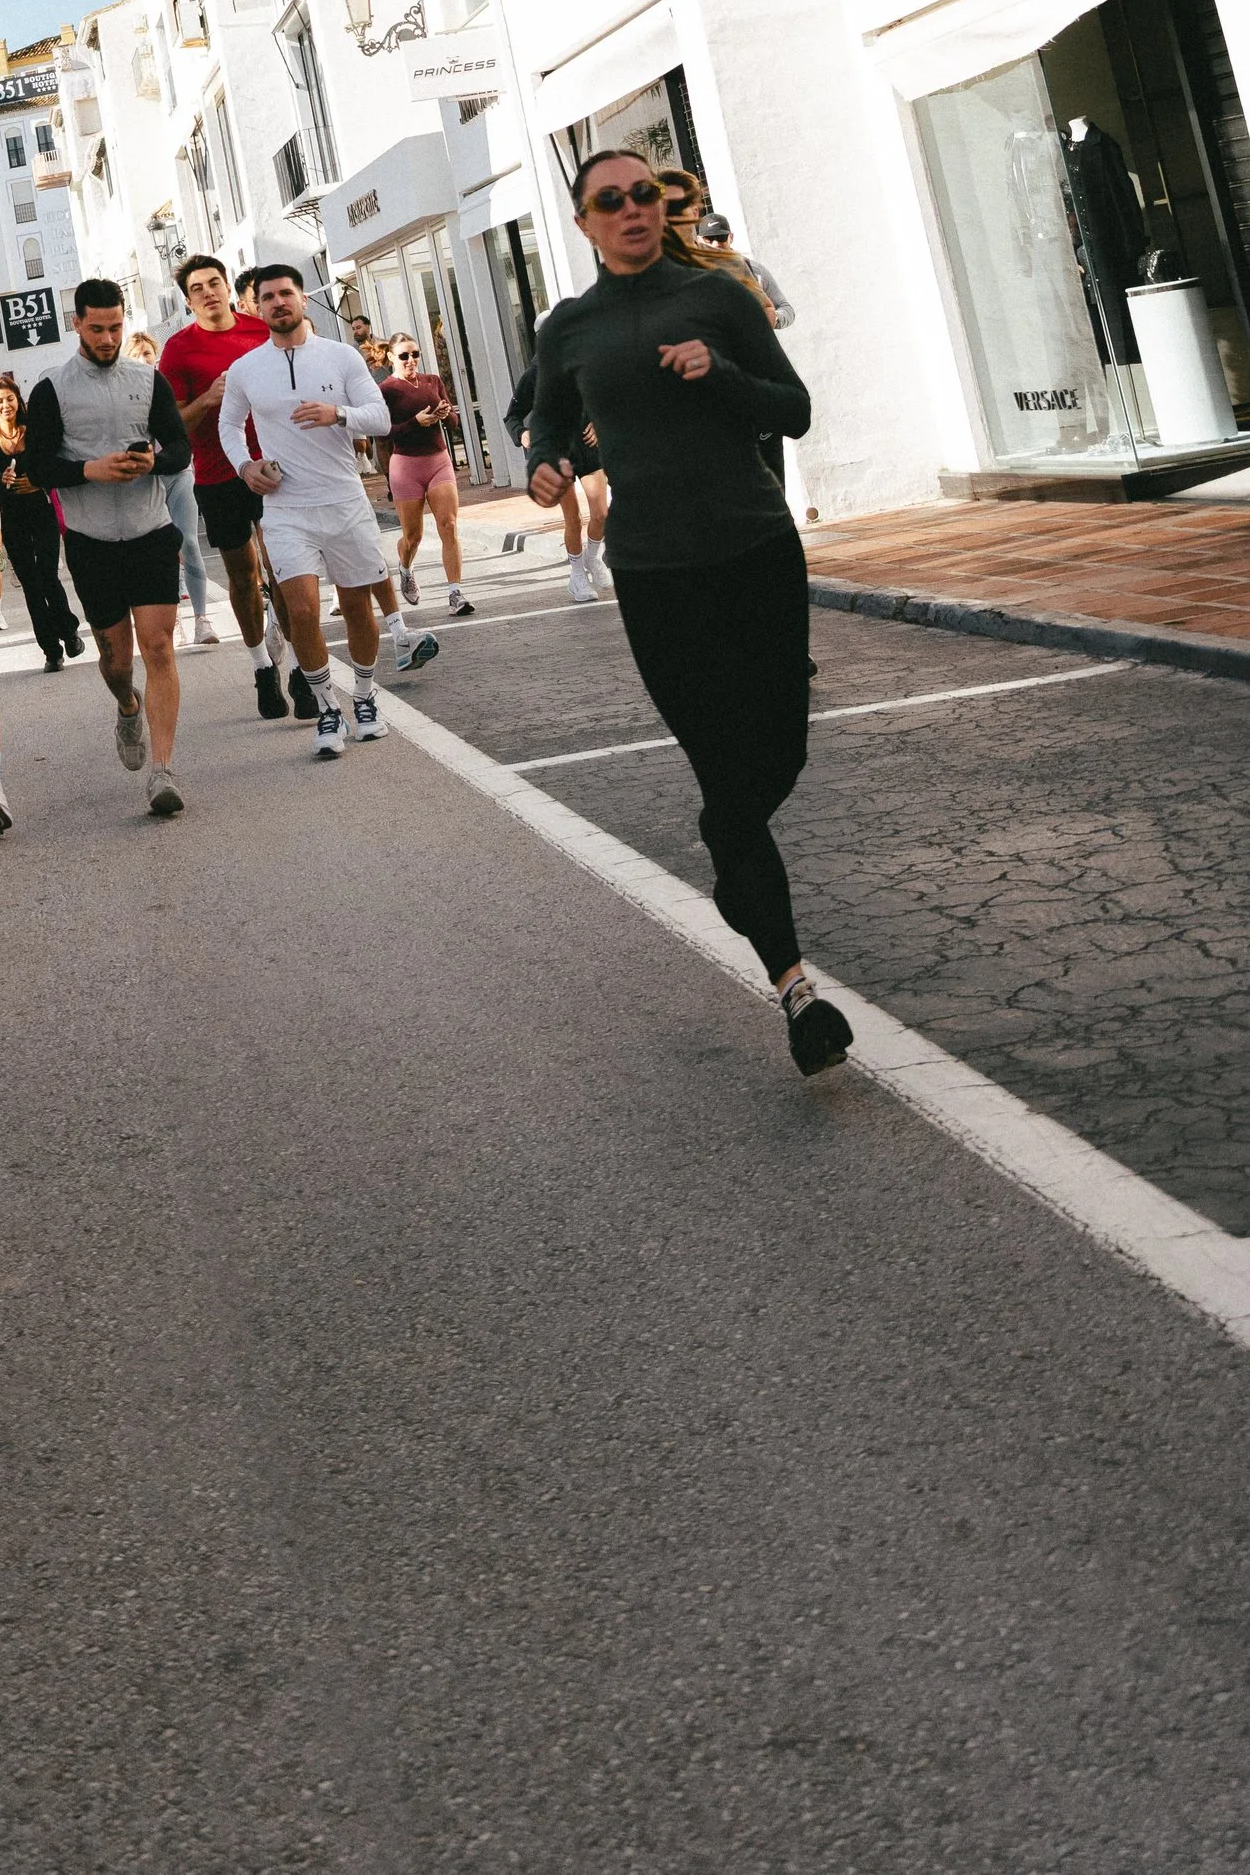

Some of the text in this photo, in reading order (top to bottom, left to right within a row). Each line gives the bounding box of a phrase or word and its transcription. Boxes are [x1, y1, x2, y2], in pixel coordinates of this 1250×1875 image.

[24, 72, 56, 84] BOUTIQ
[413, 58, 497, 79] PRINCESS
[6, 292, 51, 321] B51
[1013, 388, 1082, 411] VERSACE
